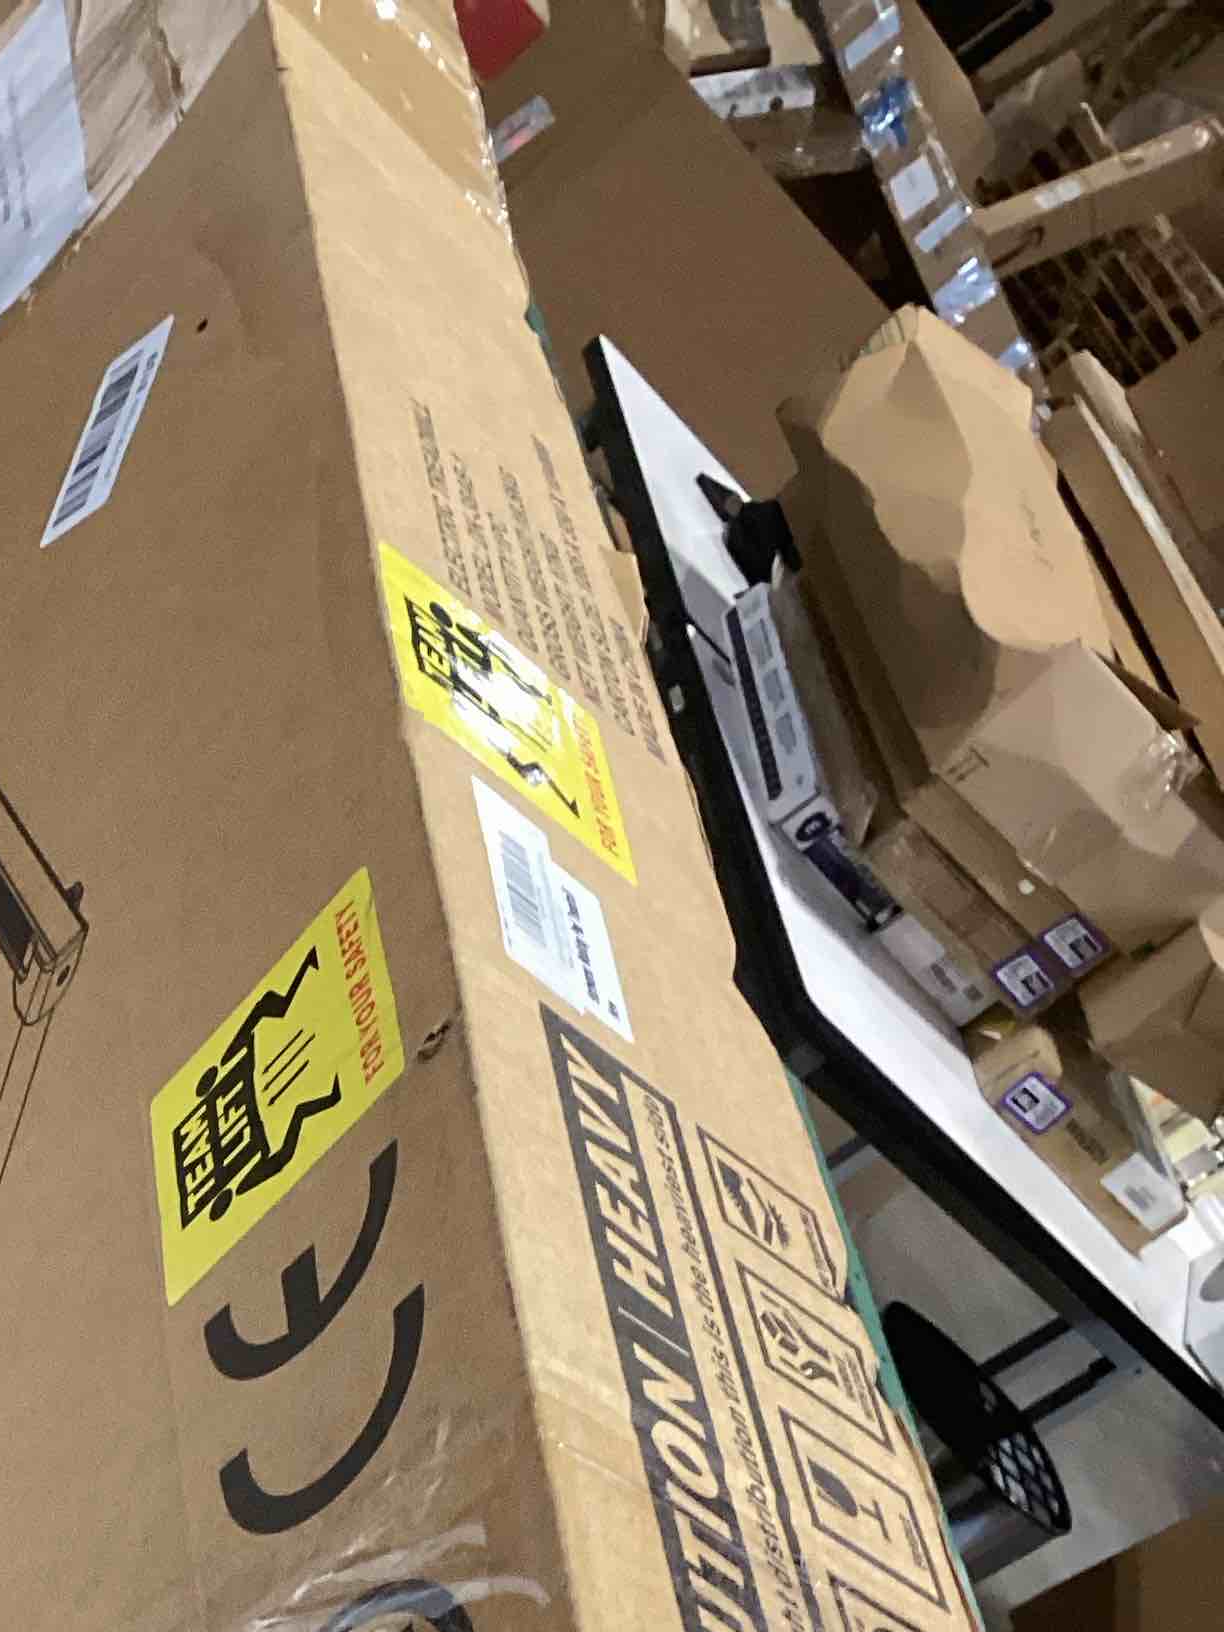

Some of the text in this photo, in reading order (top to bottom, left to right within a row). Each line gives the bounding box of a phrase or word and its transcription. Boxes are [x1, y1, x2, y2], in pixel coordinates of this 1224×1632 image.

[336, 900, 384, 1086] FOR YOUR SAFETY
[179, 1105, 215, 1215] TEAM
[216, 1080, 251, 1167] LIFT
[559, 1033, 675, 1318] HEAVY
[204, 1138, 425, 1536] CE
[690, 1265, 715, 1313] the
[702, 1314, 725, 1346] is
[712, 1345, 740, 1402] this
[730, 1405, 793, 1589] distribution
